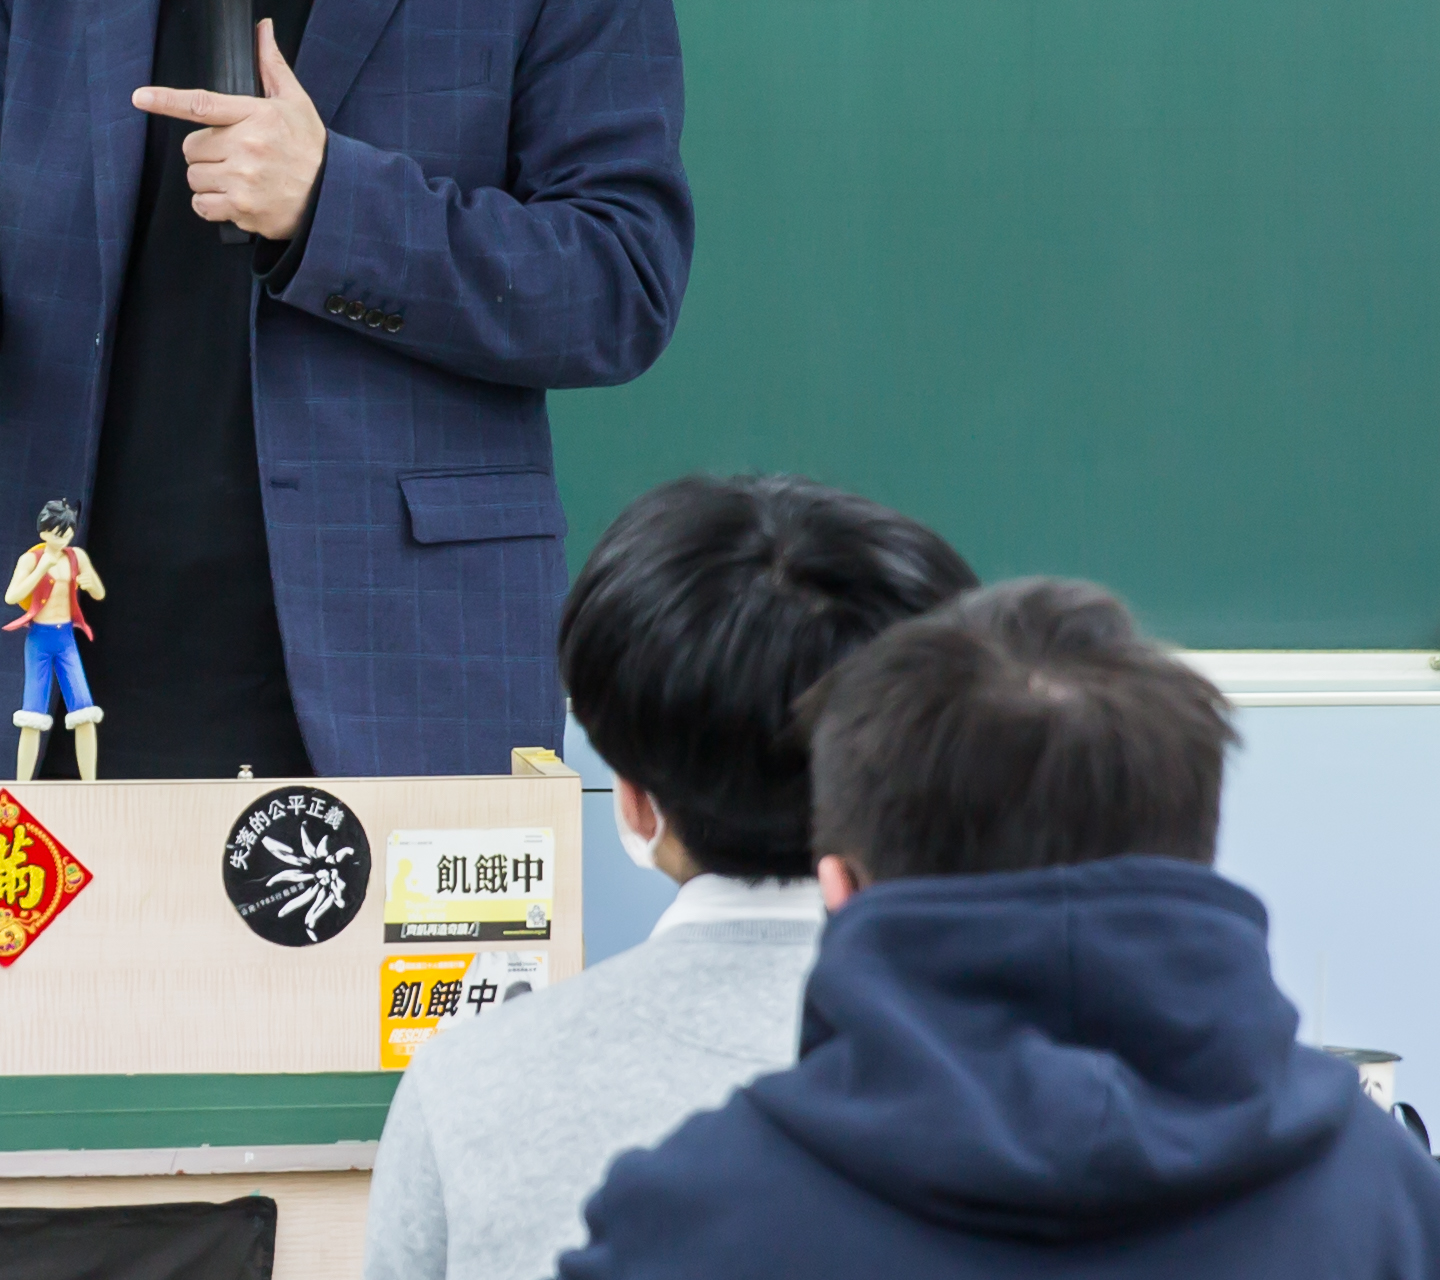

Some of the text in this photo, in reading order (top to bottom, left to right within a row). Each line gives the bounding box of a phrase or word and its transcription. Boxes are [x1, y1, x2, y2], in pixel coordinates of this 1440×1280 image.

[229, 794, 346, 871] 失落的公平正義
[436, 853, 545, 894] 飢餓中
[387, 978, 499, 1018] 飢餓中
